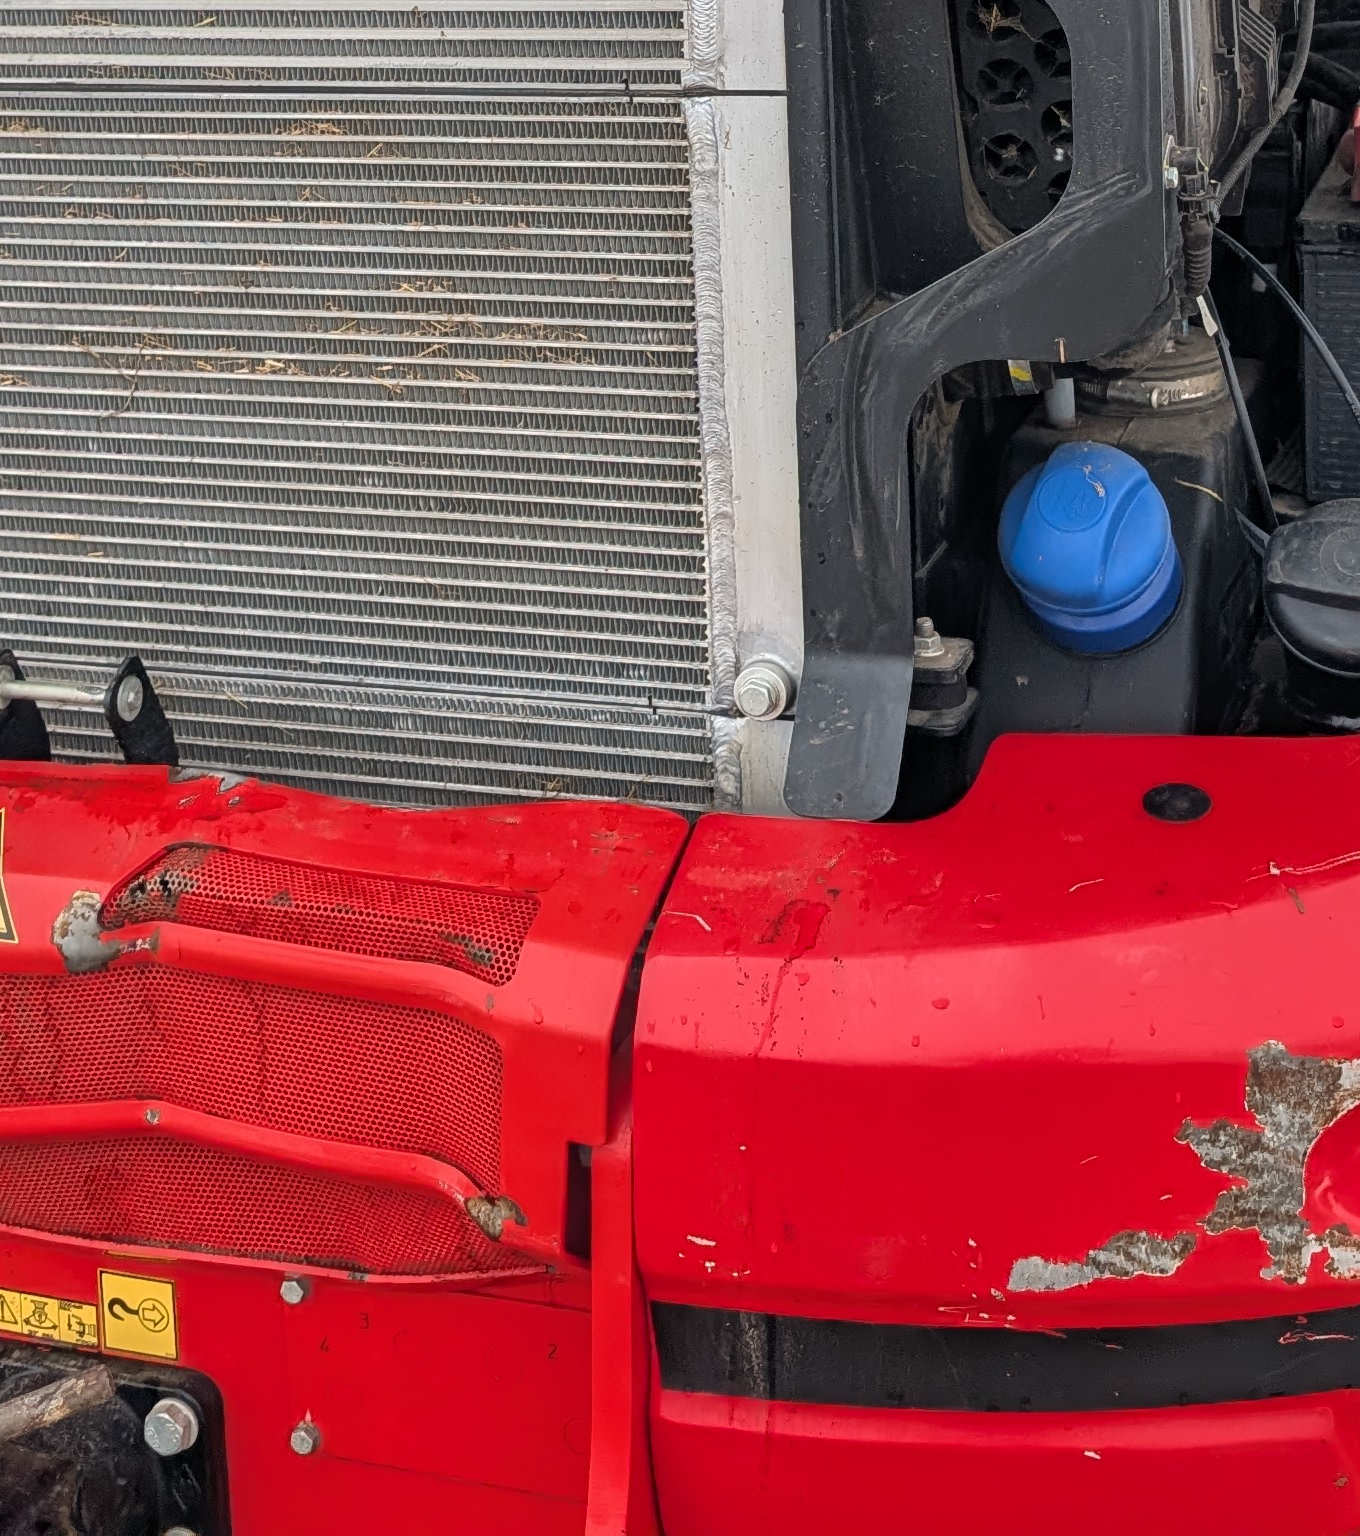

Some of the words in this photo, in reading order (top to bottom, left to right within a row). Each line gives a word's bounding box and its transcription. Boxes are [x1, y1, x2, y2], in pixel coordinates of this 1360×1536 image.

[359, 1312, 370, 1330] 3
[319, 1337, 330, 1353] 4
[546, 1343, 558, 1360] 2
